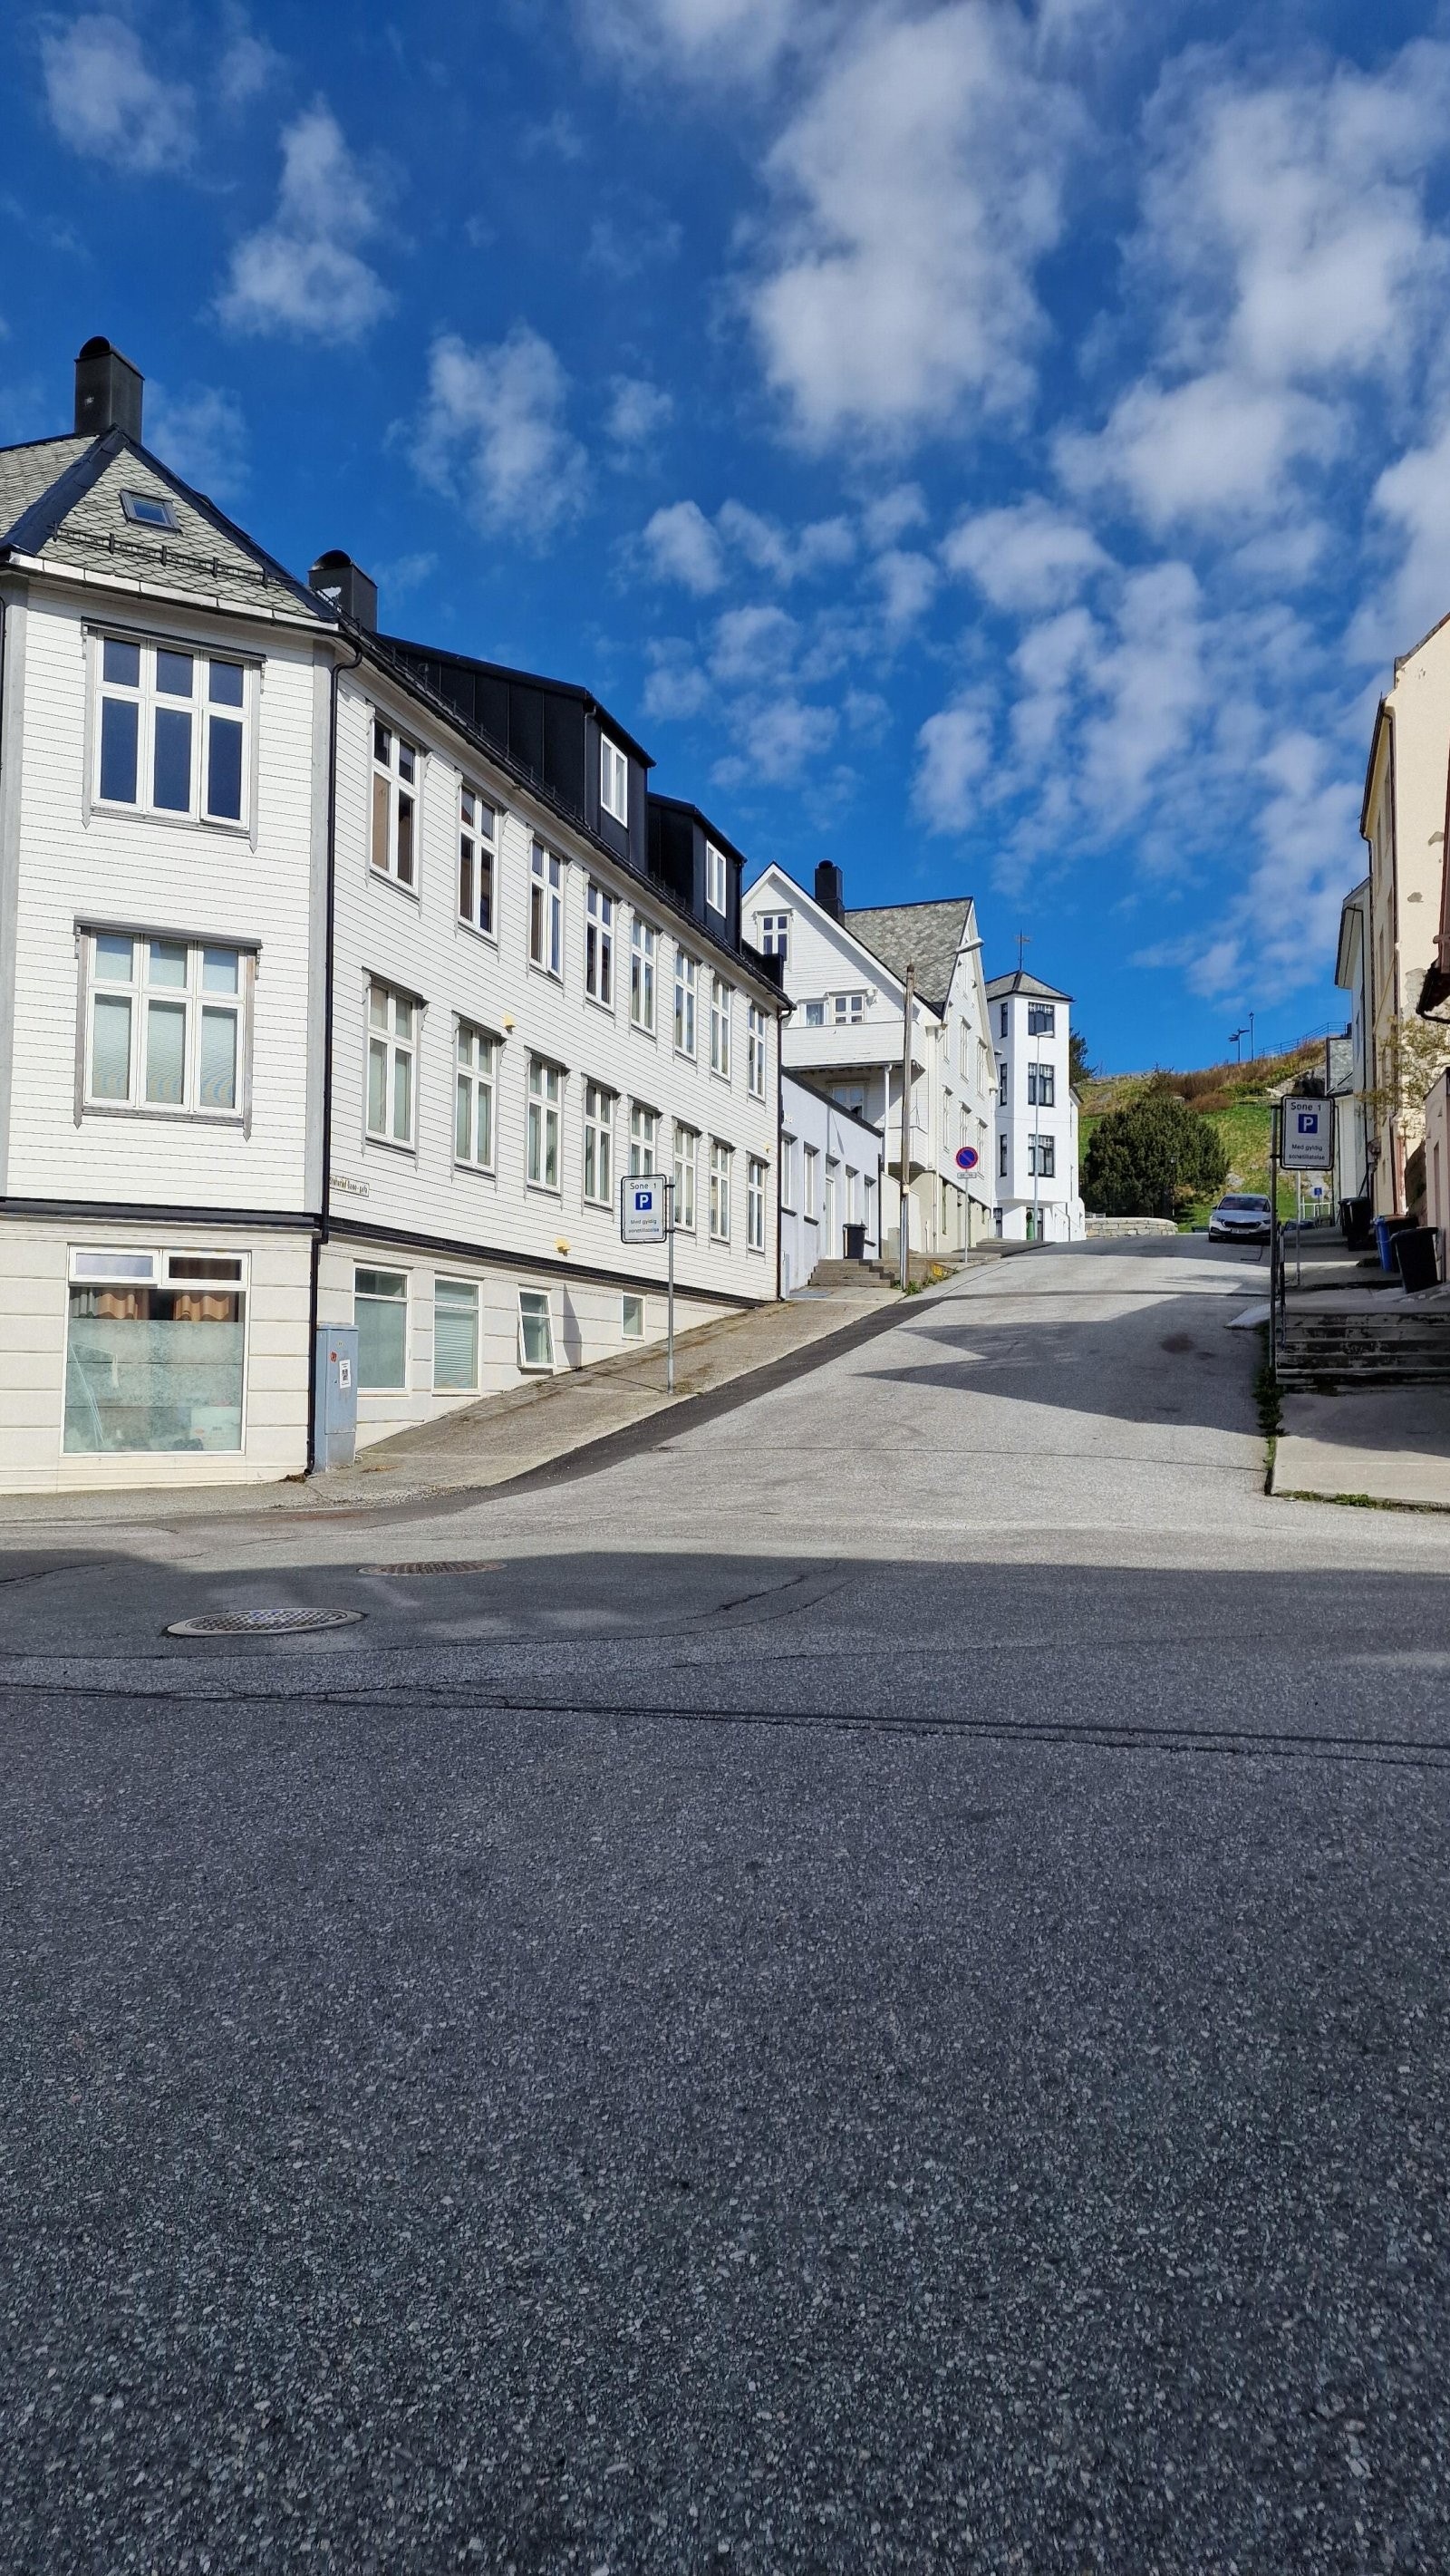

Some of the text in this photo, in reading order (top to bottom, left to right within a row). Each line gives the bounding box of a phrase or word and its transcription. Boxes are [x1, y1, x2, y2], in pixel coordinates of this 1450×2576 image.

[1290, 1102, 1313, 1111] Sone
[1303, 1117, 1314, 1132] P
[630, 1182, 649, 1190] Sone
[639, 1194, 649, 1208] P
